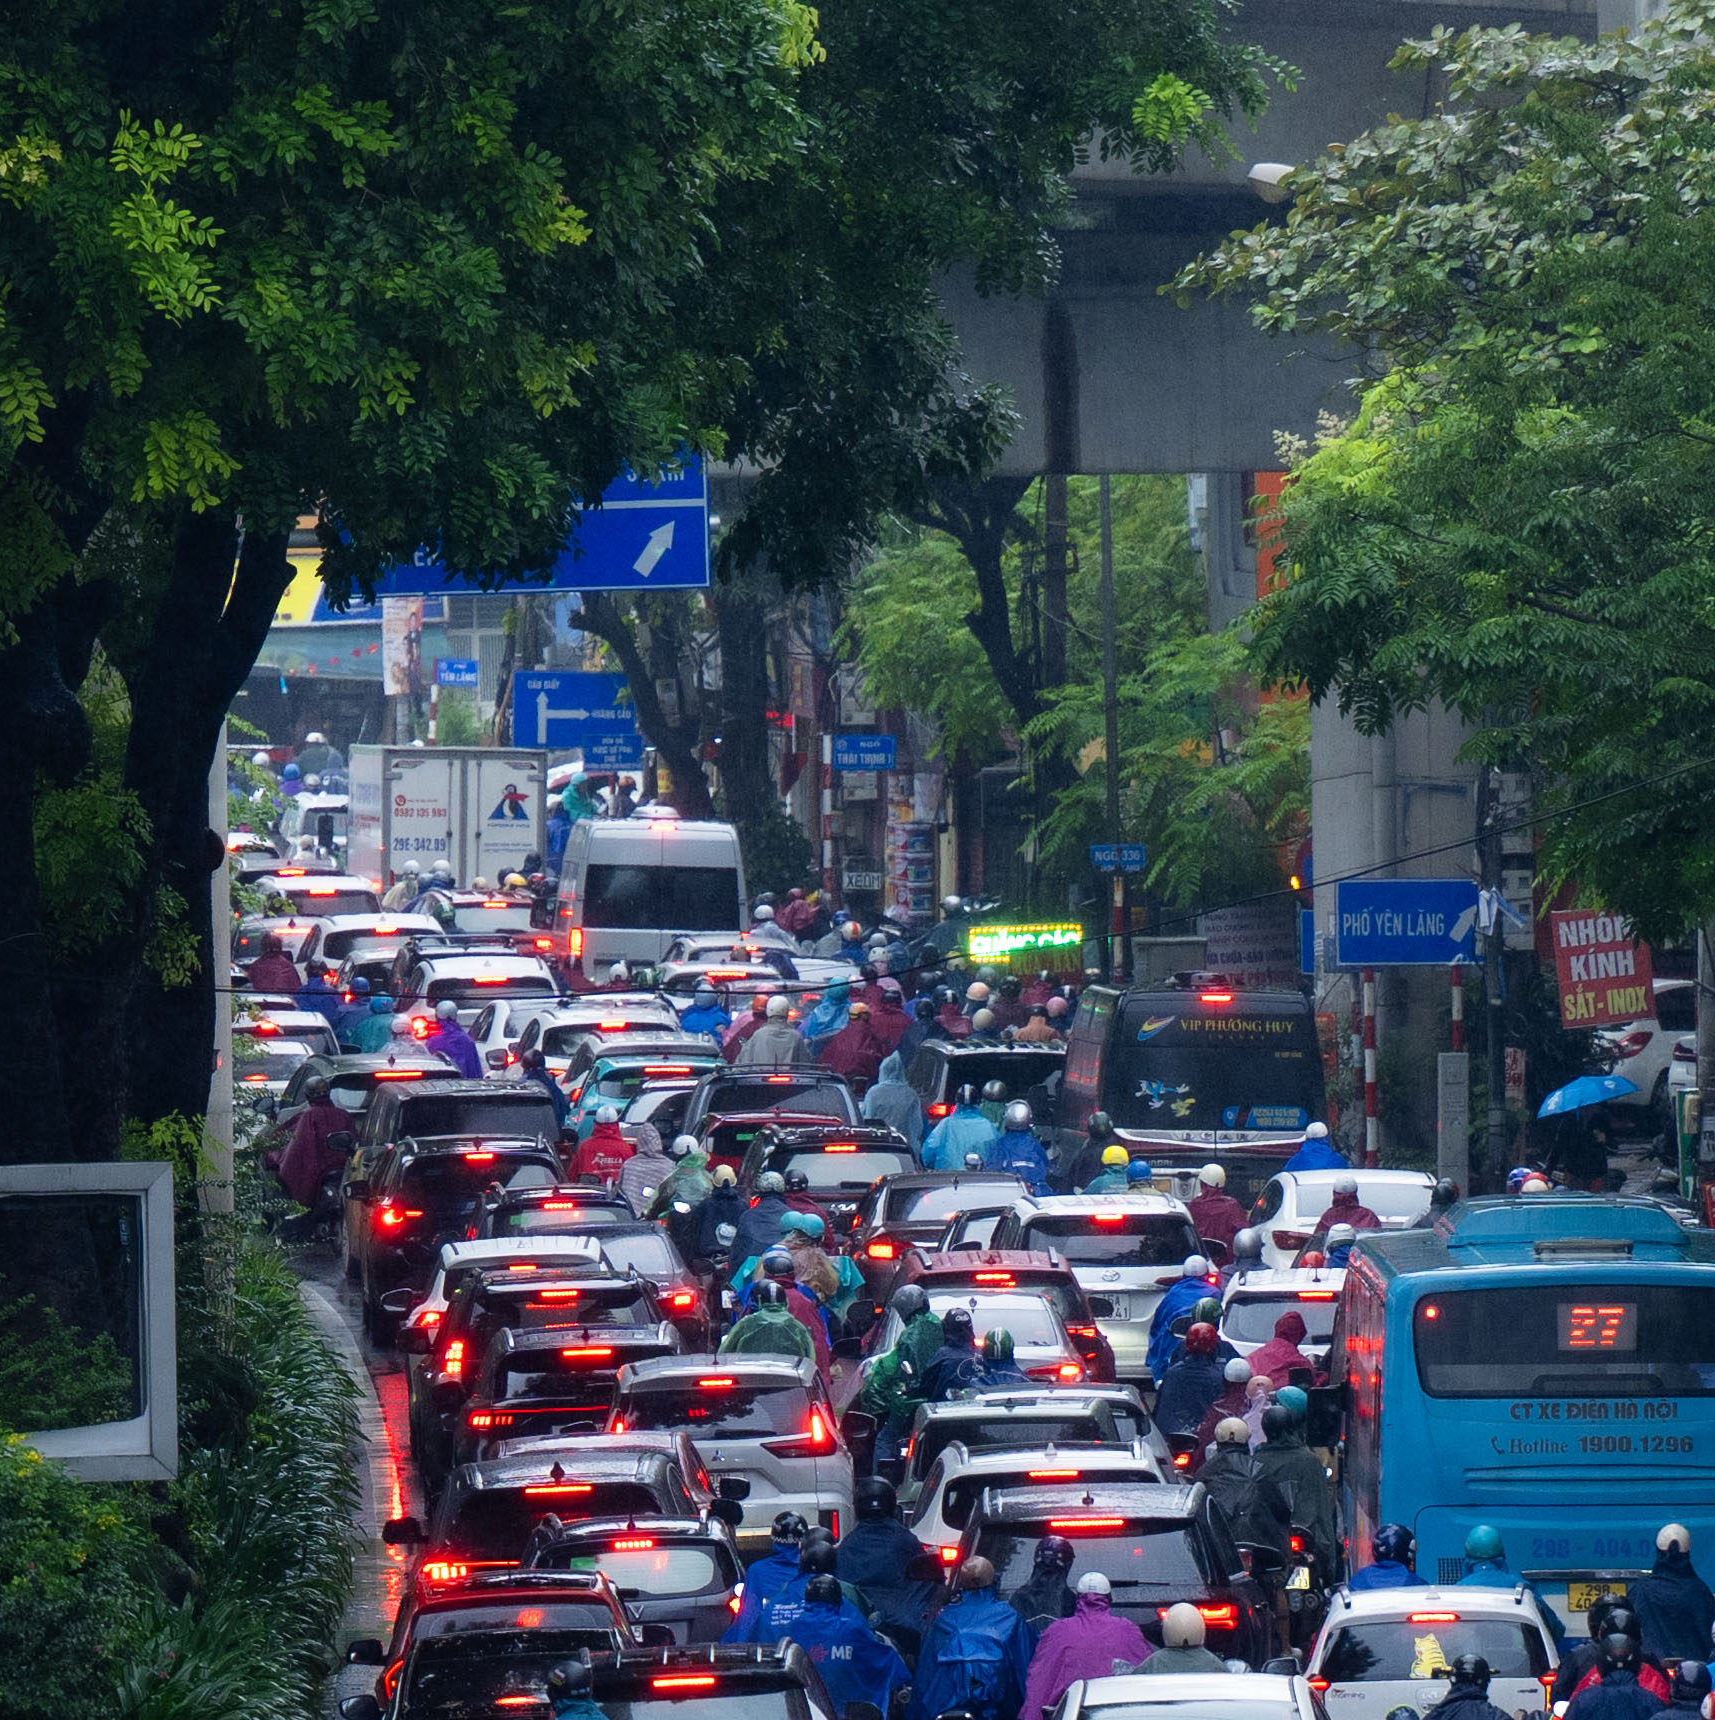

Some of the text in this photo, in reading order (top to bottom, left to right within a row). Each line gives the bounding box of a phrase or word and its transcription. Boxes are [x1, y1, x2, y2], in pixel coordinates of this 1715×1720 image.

[1343, 905, 1374, 936] PHỐ
[1376, 912, 1403, 936] YÊN
[1570, 947, 1635, 982] KÍNH
[1608, 986, 1649, 1017] INOX
[1181, 1019, 1201, 1031] VIP
[1265, 1020, 1294, 1033] HUY
[1569, 1307, 1624, 1345] 27
[1510, 1402, 1533, 1420] CT
[1538, 1402, 1561, 1420] XE
[1644, 1399, 1678, 1424] NỘI
[1509, 1435, 1693, 1454] Hotline 1900.1296
[831, 1646, 853, 1660] MB
